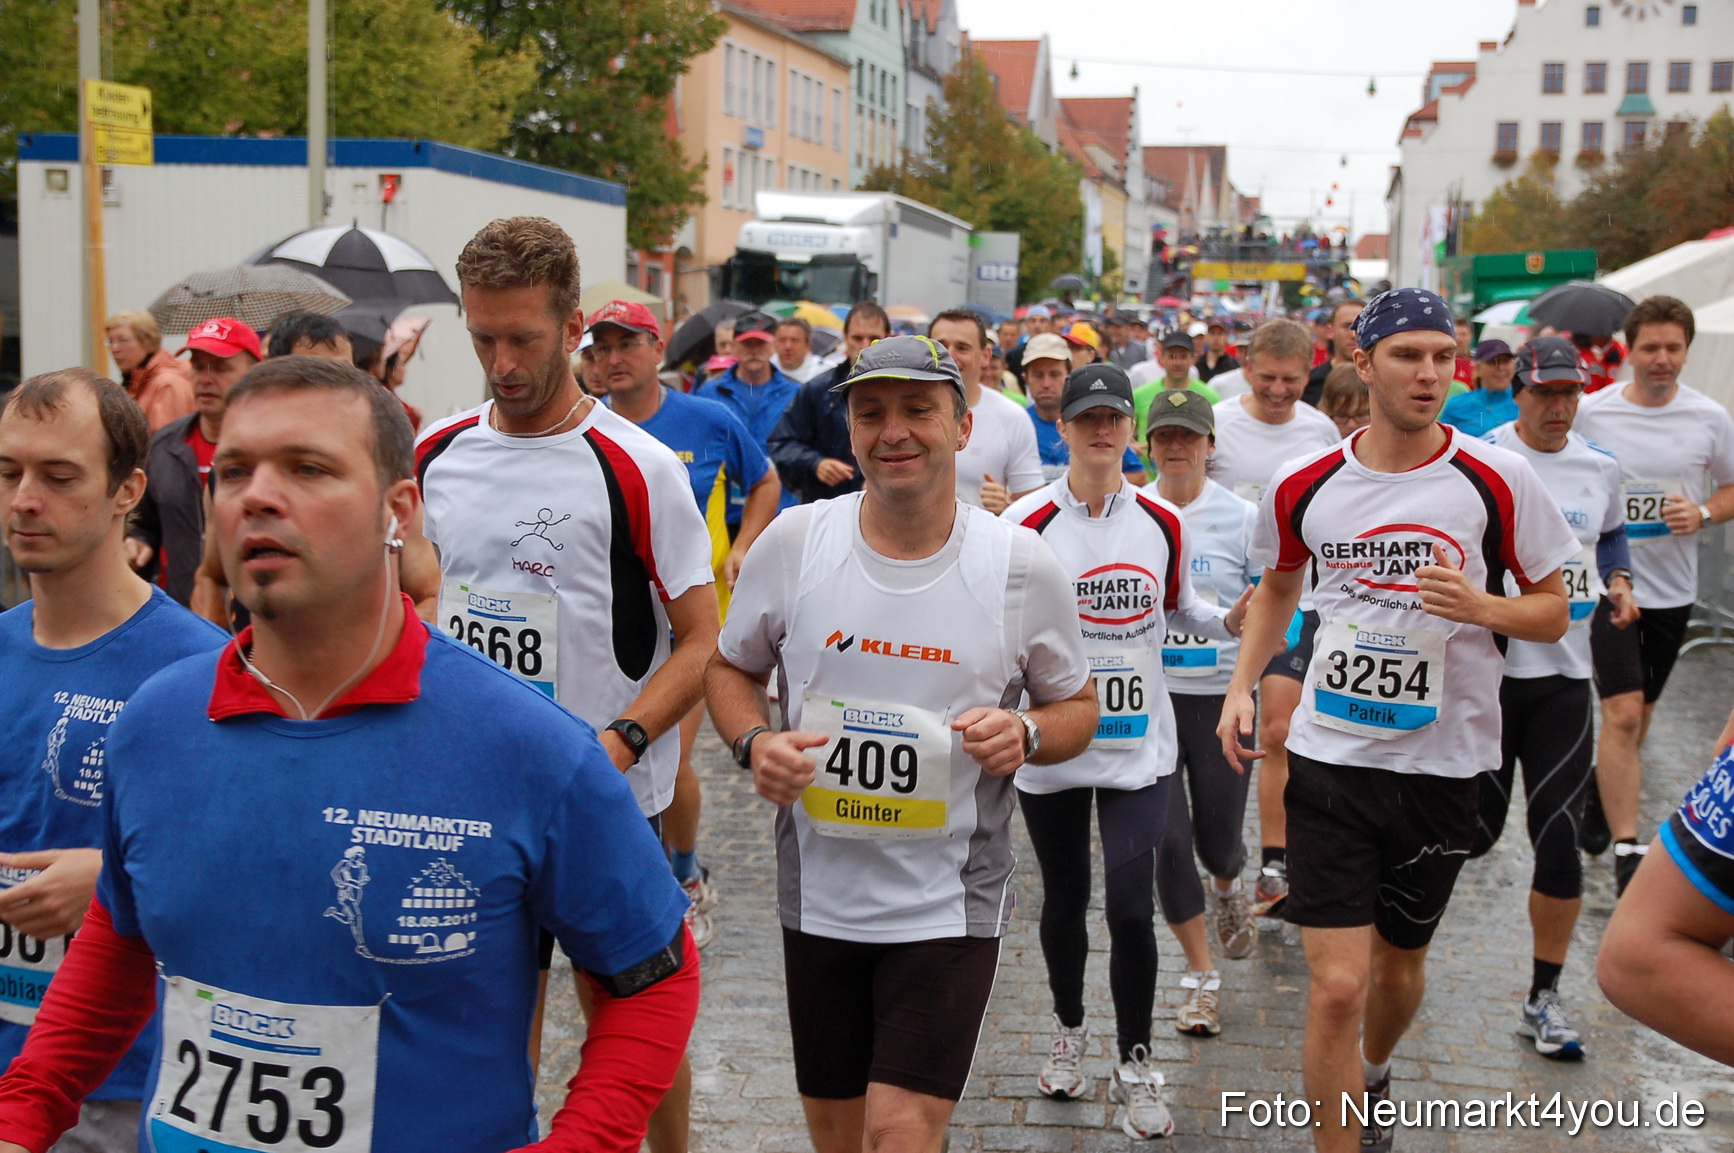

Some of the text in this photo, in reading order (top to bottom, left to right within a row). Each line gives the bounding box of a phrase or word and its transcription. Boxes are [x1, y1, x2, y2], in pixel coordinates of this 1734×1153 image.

[1321, 541, 1434, 559] GERHART
[511, 557, 555, 577] MARC
[1325, 561, 1373, 569] Autohaus
[1373, 559, 1440, 576] JÄN
[1073, 578, 1141, 597] RHART
[468, 593, 511, 612] BOCK
[1091, 595, 1152, 611] JÄNIG
[1358, 593, 1408, 611] sportliche
[1357, 631, 1406, 647] BOCK
[861, 638, 960, 665] KLEBL
[1326, 650, 1430, 700] 3254
[53, 691, 128, 712] 12. NEUMAR
[843, 708, 904, 728] BOCK
[1349, 703, 1396, 725] Patrik
[79, 768, 104, 779] 18.0
[825, 737, 918, 794] 409
[836, 798, 902, 823] Günter
[322, 807, 493, 838] 12. NEUMARKTER
[351, 827, 465, 851] STADTLAUF
[397, 912, 477, 928] 18.09.2011
[211, 1004, 296, 1039] BOCK
[169, 1039, 345, 1149] 2753
